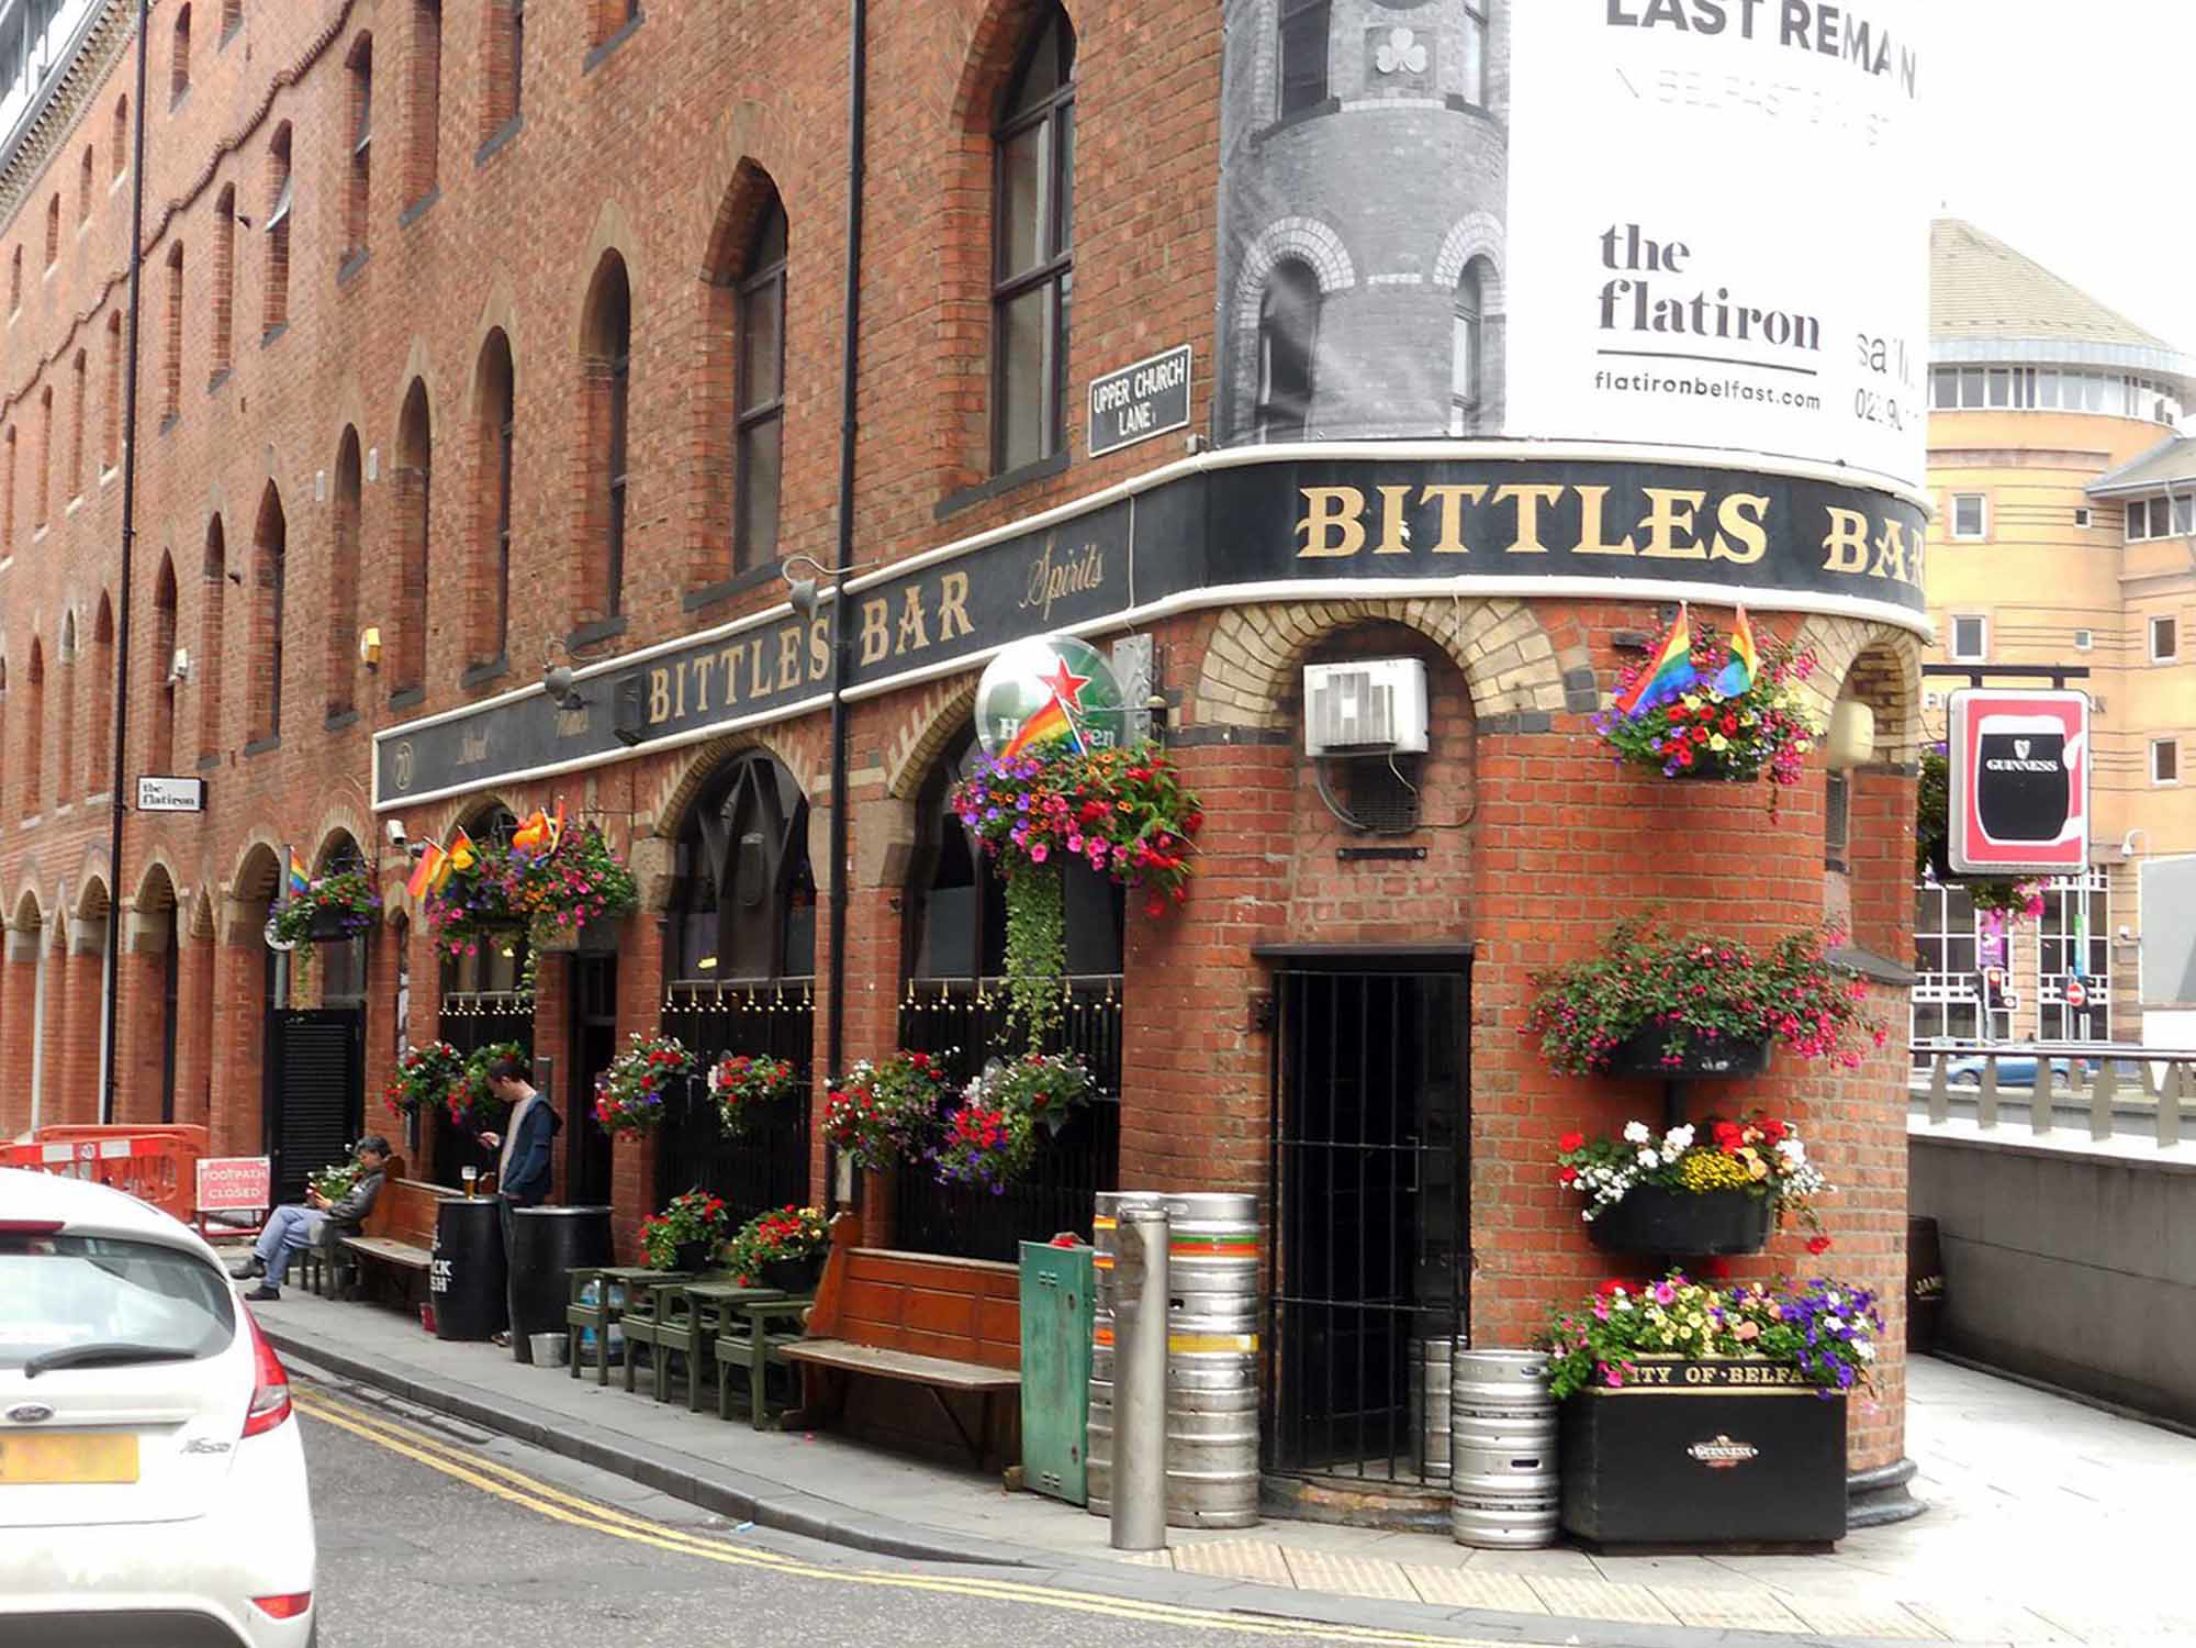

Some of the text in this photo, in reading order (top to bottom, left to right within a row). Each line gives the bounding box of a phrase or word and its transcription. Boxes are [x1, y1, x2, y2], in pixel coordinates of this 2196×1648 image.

[1600, 223, 1690, 273] the
[1598, 278, 1820, 350] flatiron
[1093, 356, 1185, 413] UPPER CHURCH
[1594, 371, 1821, 410] flatironbelfast.com
[1118, 402, 1152, 436] LANE
[1295, 485, 1771, 565] BITTLES
[648, 535, 1106, 726] BITTLES BAR Spirits
[1986, 758, 2059, 772] GUINNESS
[143, 784, 162, 792] the
[203, 1168, 264, 1182] FOOTPATH
[208, 1189, 260, 1199] CLOSED
[1631, 1366, 1813, 1384] ITY OF BELFA
